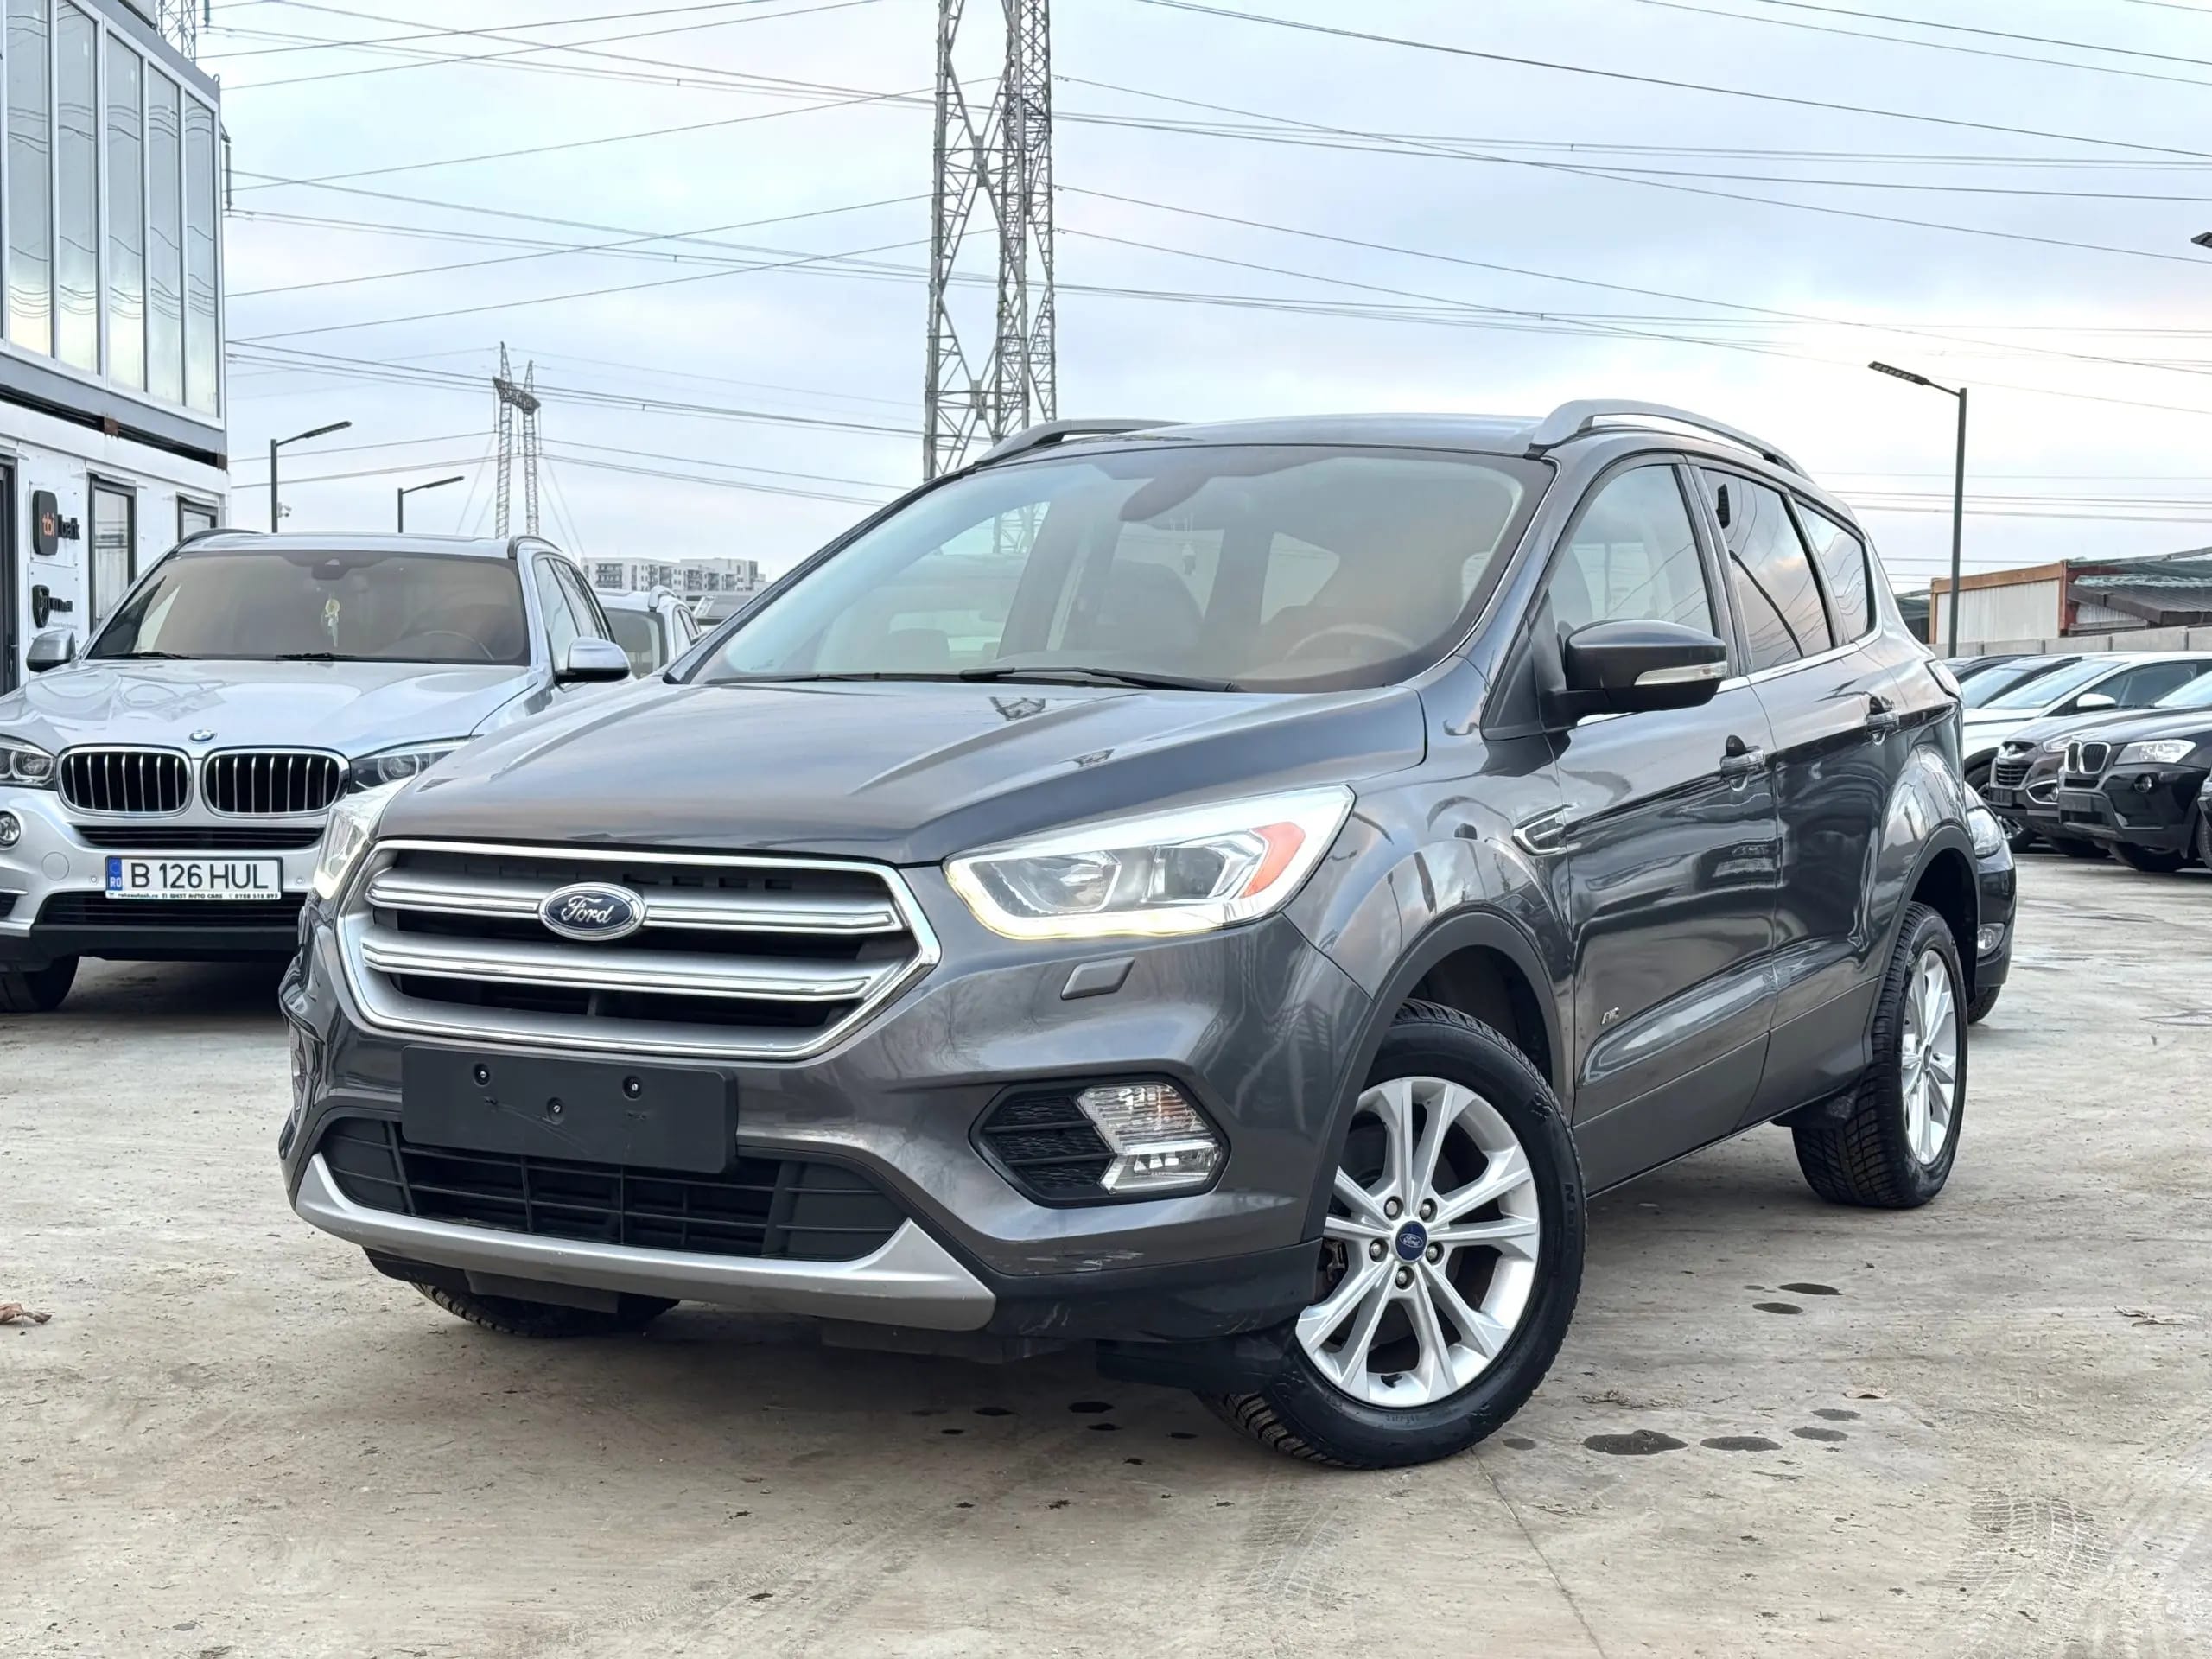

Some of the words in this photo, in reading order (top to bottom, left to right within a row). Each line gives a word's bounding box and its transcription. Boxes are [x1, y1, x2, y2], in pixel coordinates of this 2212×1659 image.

[41, 512, 54, 537] tbi
[110, 876, 122, 888] RO
[130, 862, 150, 889] B
[159, 862, 203, 889] 126
[210, 863, 269, 889] HUL
[560, 895, 615, 924] Ford
